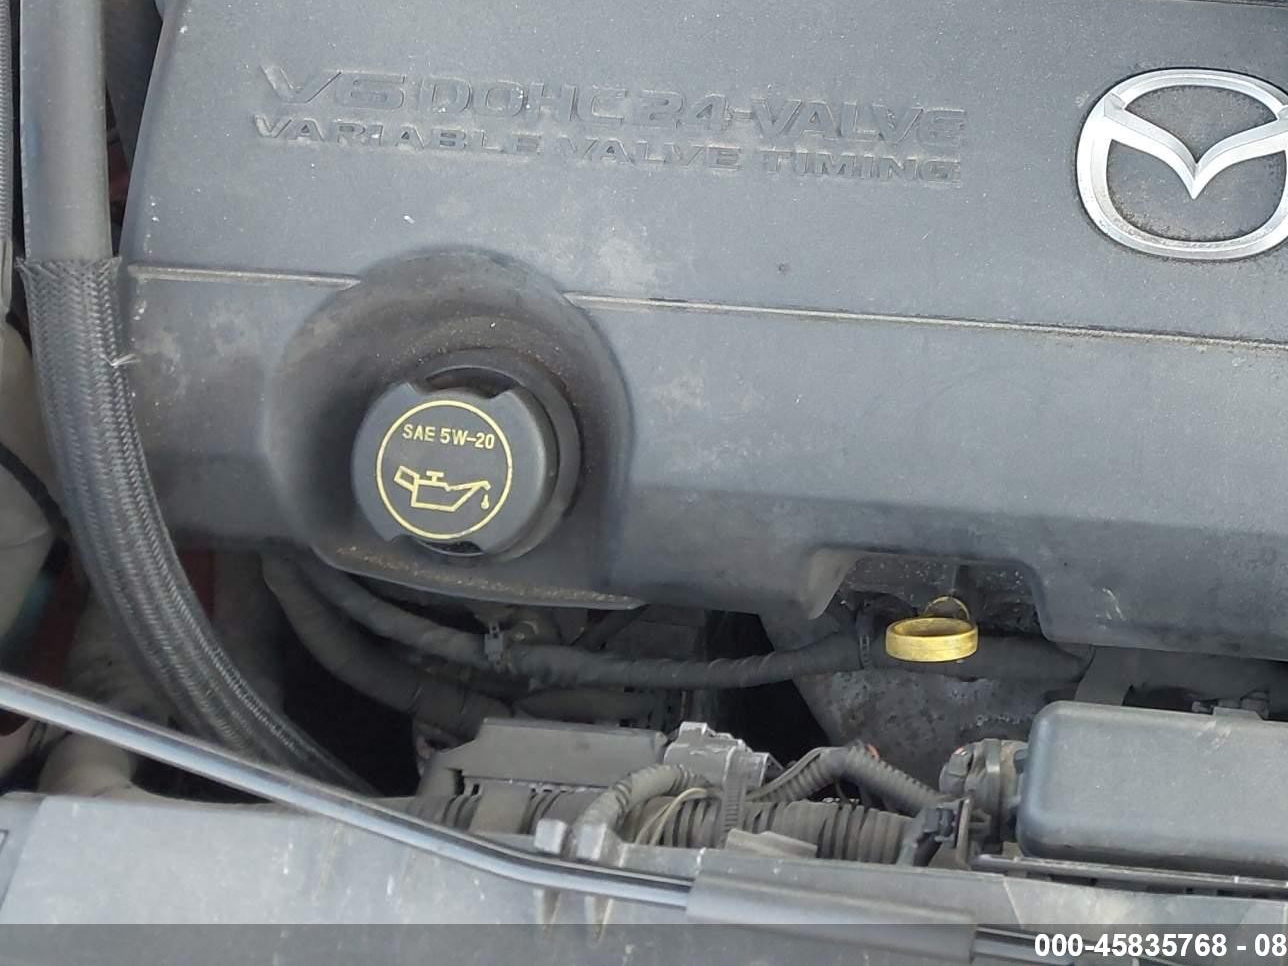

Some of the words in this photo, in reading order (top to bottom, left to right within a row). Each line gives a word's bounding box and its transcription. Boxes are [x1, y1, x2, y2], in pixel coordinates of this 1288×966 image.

[259, 65, 407, 111] V6
[418, 74, 628, 126] DOHC
[635, 89, 967, 147] 24-VALVE
[254, 113, 544, 157] VARIABLE
[556, 132, 743, 172] VALVE
[757, 146, 962, 185] TIMING
[402, 423, 436, 442] SAE
[439, 427, 496, 450] 5W-20
